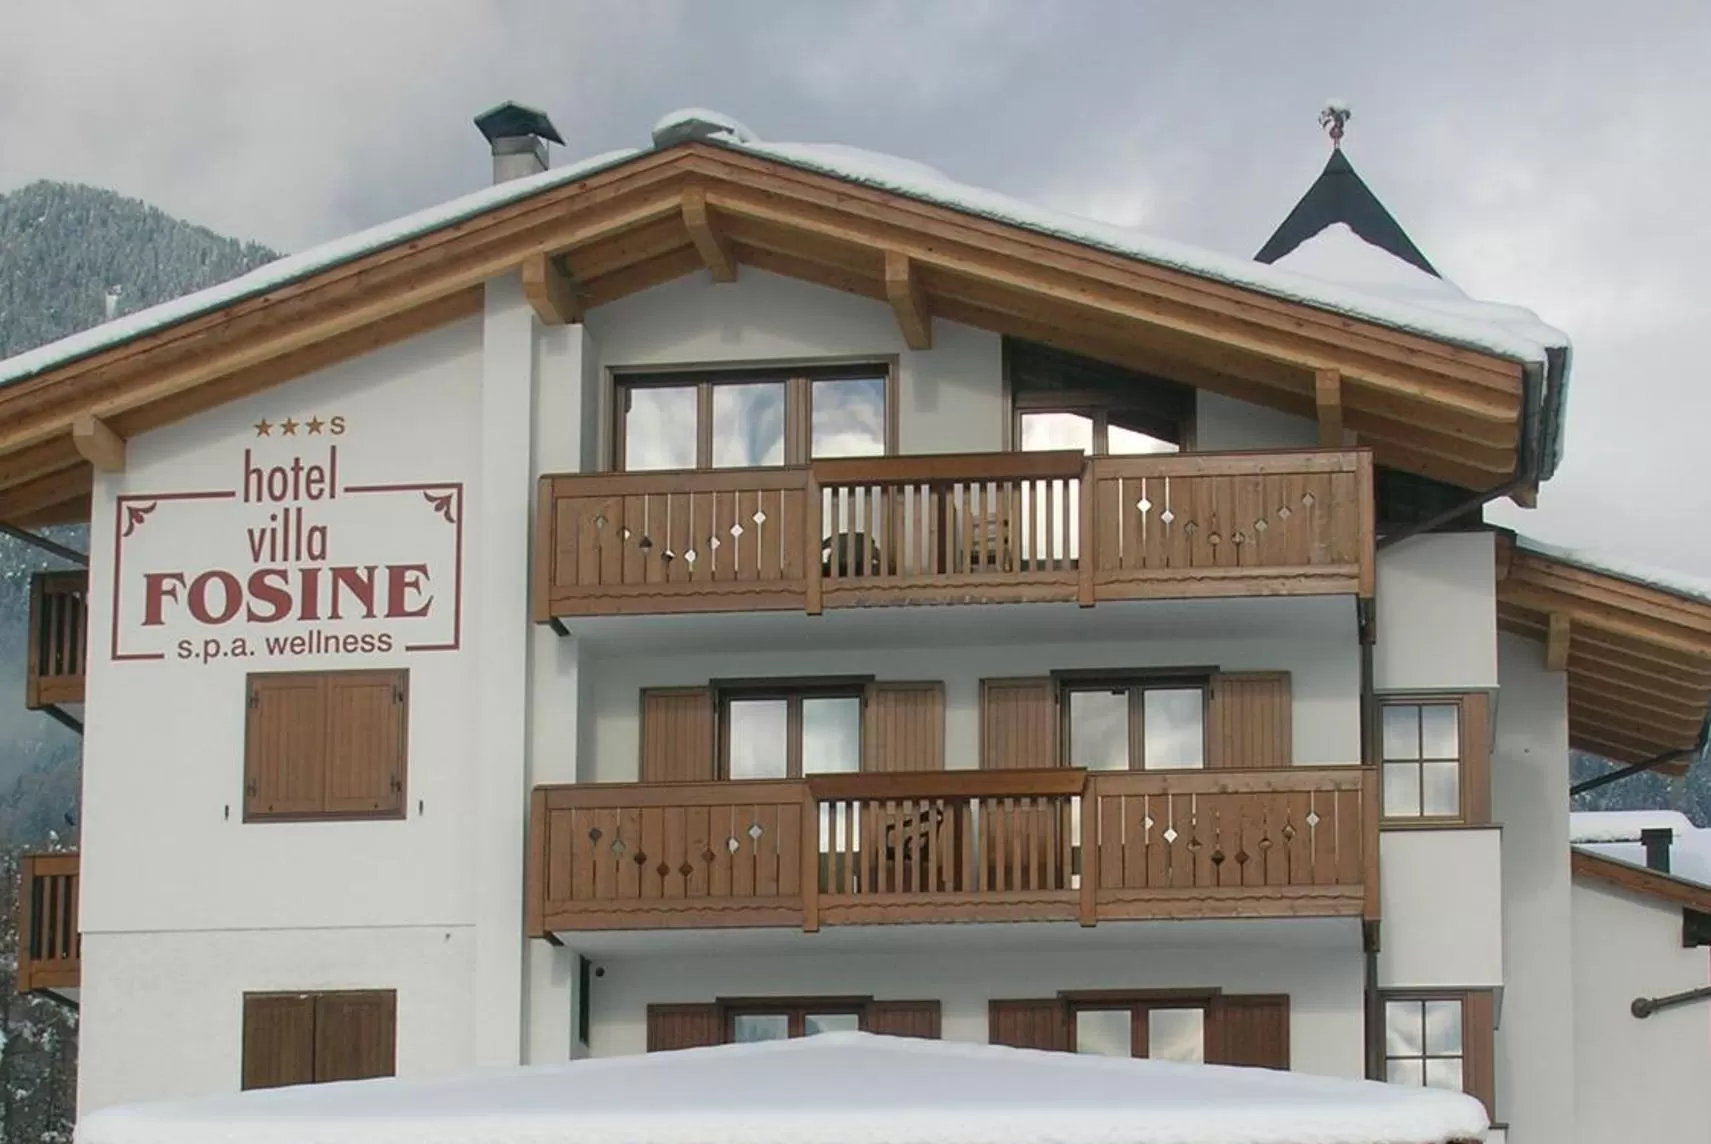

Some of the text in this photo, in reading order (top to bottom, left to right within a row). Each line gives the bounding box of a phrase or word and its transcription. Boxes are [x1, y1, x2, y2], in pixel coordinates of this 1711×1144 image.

[243, 445, 337, 503] hotel
[247, 507, 328, 563] villa
[141, 564, 434, 626] FOSINE
[177, 630, 393, 664] s.p.a. wellness
